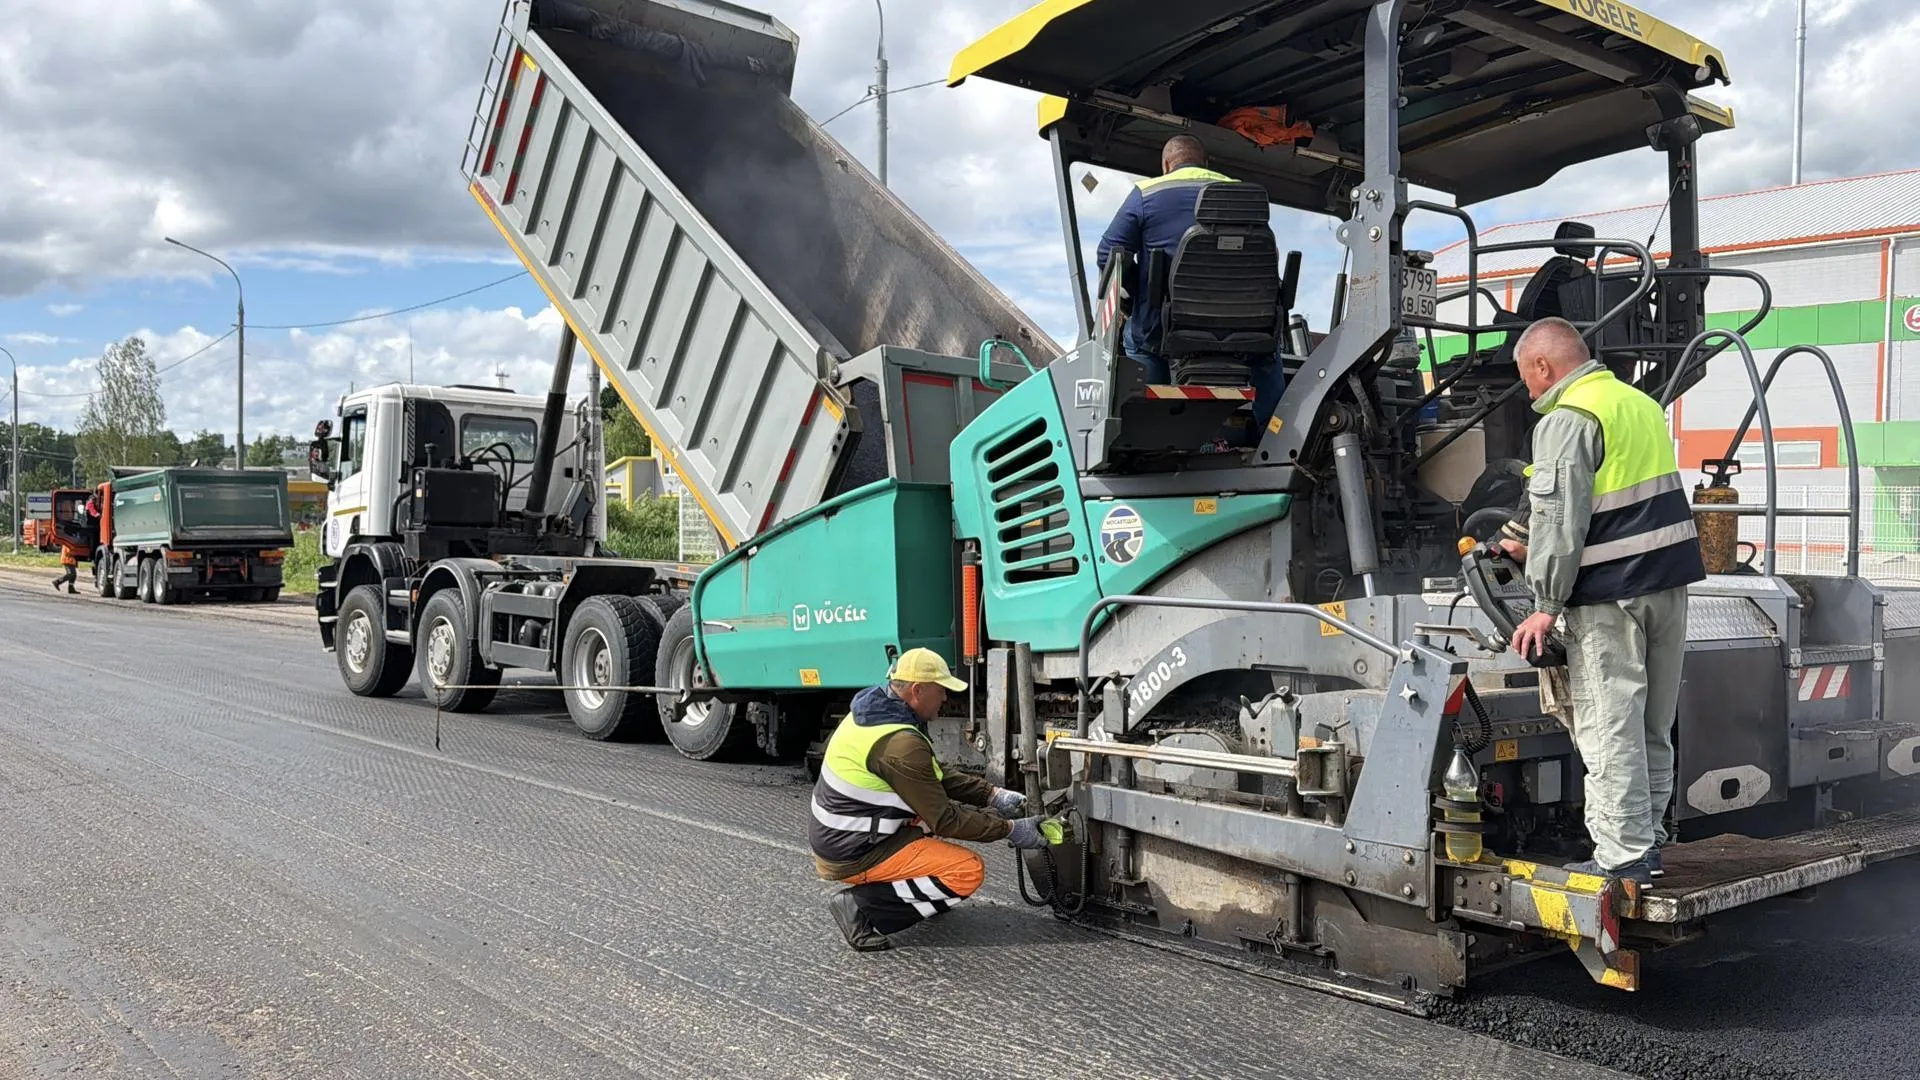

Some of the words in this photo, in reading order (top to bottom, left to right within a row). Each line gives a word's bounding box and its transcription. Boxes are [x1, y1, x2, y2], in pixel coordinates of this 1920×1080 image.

[1402, 269, 1433, 292] 3799
[1421, 299, 1434, 316] 50
[1130, 646, 1187, 707] 1800-3
